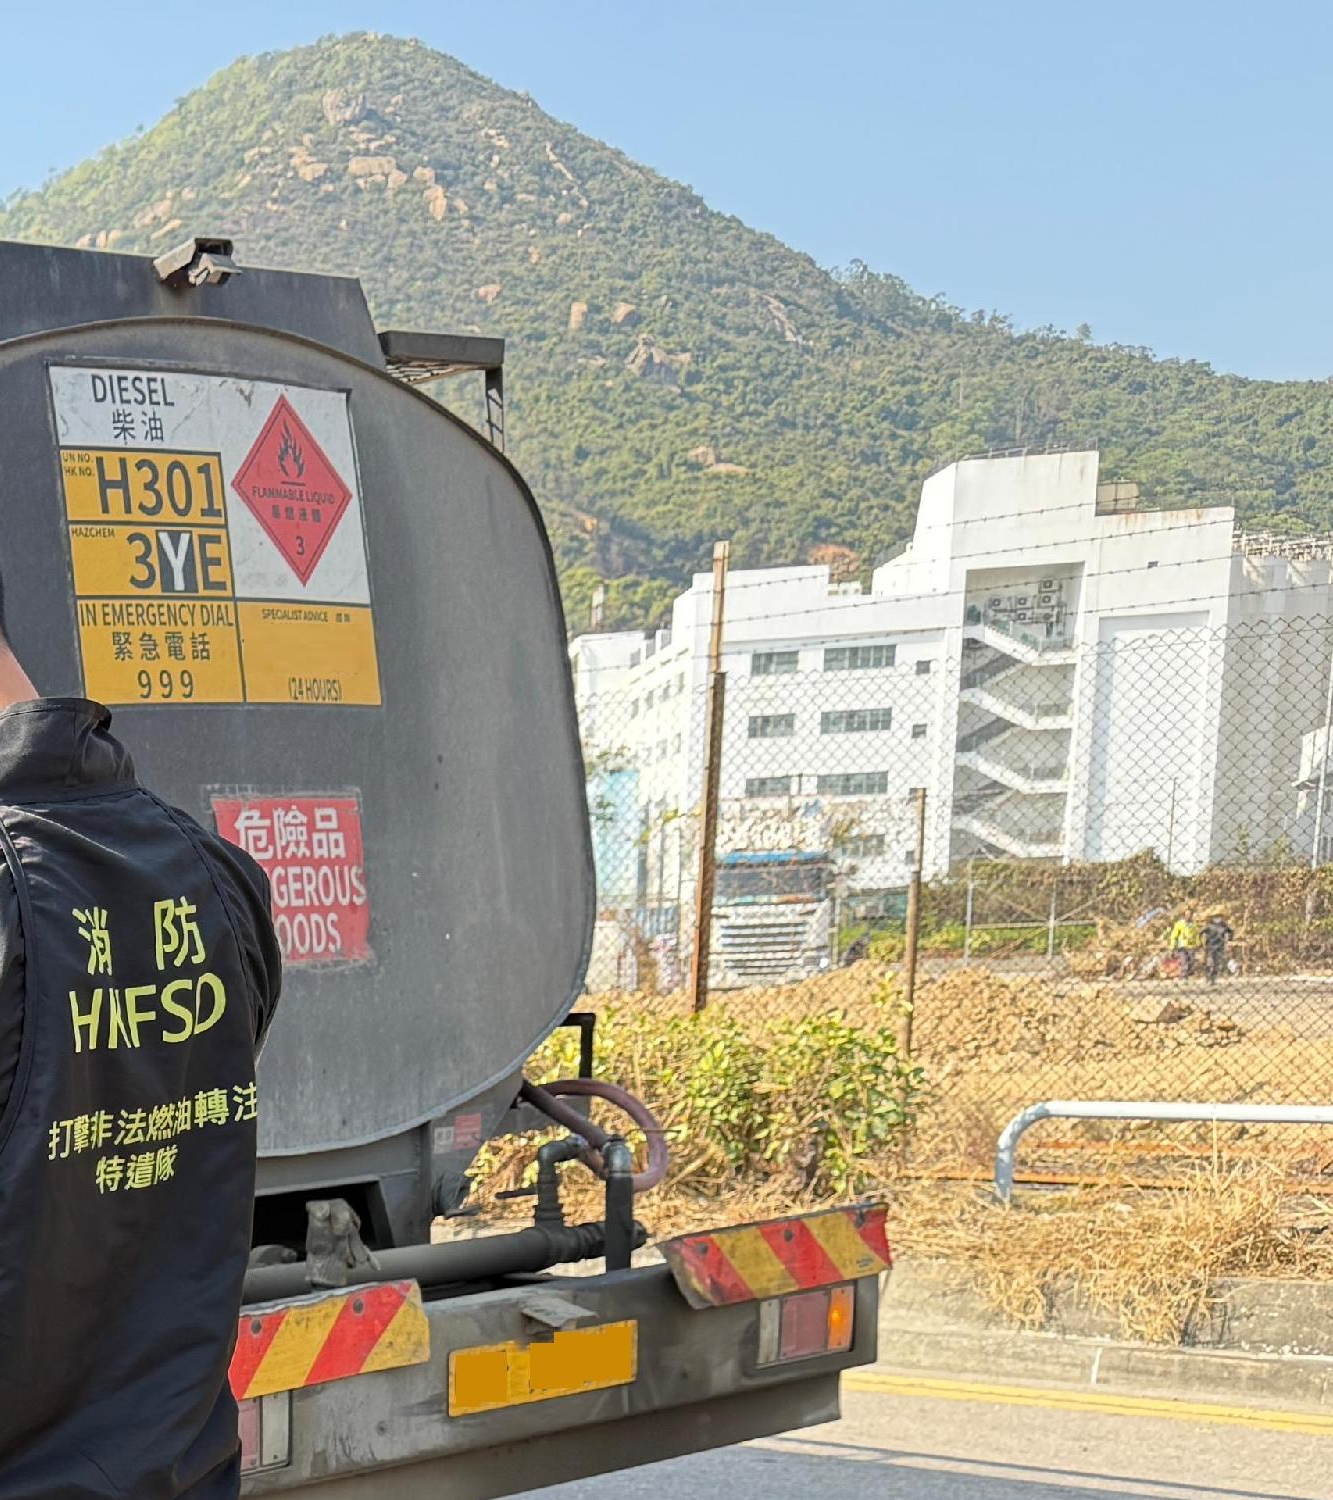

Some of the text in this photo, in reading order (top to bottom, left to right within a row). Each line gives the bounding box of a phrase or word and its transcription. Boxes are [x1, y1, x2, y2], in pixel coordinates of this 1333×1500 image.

[91, 374, 175, 407] DIESEL
[112, 411, 164, 443] 柴油
[62, 452, 75, 462] UN
[65, 466, 77, 476] HK
[95, 455, 222, 518] H301
[252, 485, 336, 506] FLAMMABLE LIQUID
[71, 527, 116, 538] HAZCHEM
[295, 536, 305, 556] 3
[127, 530, 227, 592] 3YE
[80, 603, 234, 628] IN EMERGENCY DIAL
[262, 608, 302, 622] SPECIALIST
[304, 610, 329, 623] ADVICE
[112, 632, 211, 662] 緊急電話
[137, 669, 194, 700] 999
[288, 677, 342, 702] (24 HOURS)
[235, 805, 346, 860] 危險品
[269, 865, 367, 907] GEROUS
[71, 896, 206, 976] 消防
[274, 912, 341, 954] OODS
[48, 1082, 258, 1160] 打擊非法燃油轉注
[95, 1144, 179, 1194] 特遣隊
